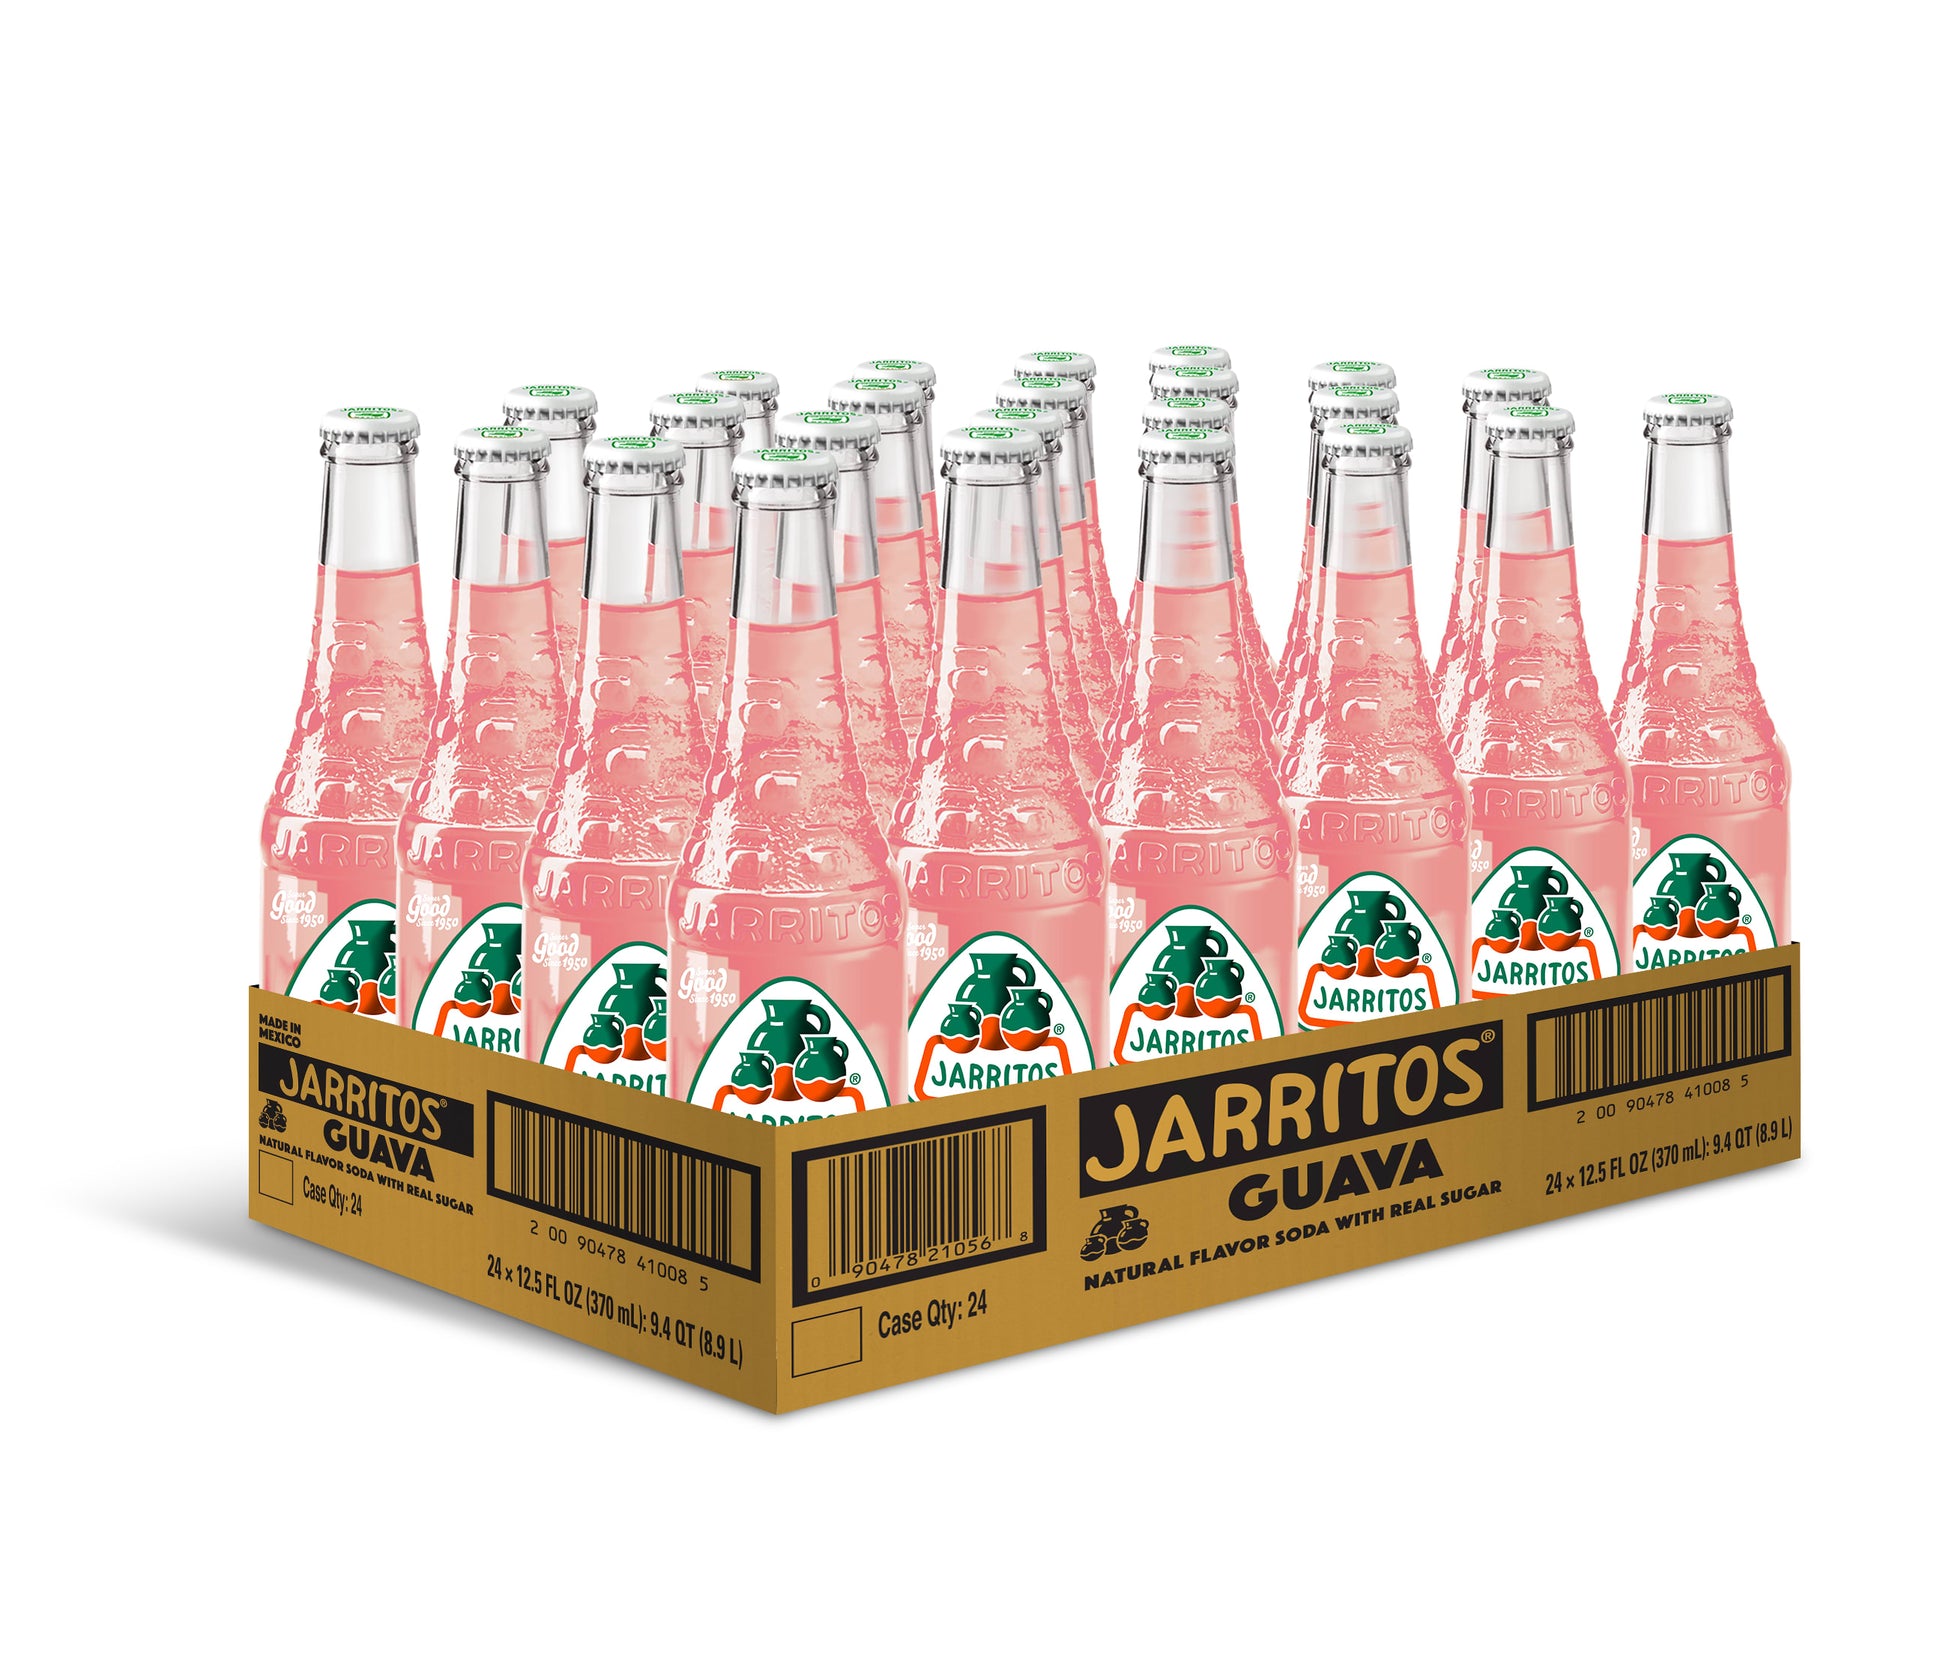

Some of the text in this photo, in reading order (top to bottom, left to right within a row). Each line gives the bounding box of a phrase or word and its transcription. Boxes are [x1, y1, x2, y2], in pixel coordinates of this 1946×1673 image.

[1471, 860, 1489, 873] 950
[270, 890, 316, 920] Good
[1303, 884, 1326, 898] 1950
[300, 913, 325, 928] 1950
[405, 894, 450, 923] Good
[434, 917, 459, 931] 1950
[907, 922, 937, 947] ood
[1119, 919, 1143, 933] 1950
[531, 932, 579, 963] Good
[920, 946, 945, 961] 1950
[562, 956, 588, 971] 1950
[1477, 959, 1589, 986] JARRITOS
[677, 967, 727, 1000] Good
[709, 992, 737, 1007] 1950
[1313, 986, 1427, 1013] JARRITOS
[259, 1013, 301, 1035] MADE IN
[259, 1026, 300, 1048] MEXICO
[453, 1024, 521, 1053] JARRI
[1577, 1074, 1748, 1123] 2 00 90478 41008 5
[323, 1119, 434, 1182] GUAVA
[1546, 1171, 1562, 1195] 24
[1579, 1161, 1606, 1186] 12.5
[1610, 1156, 1625, 1179] FL
[1629, 1150, 1647, 1174] OZ
[1651, 1143, 1678, 1172] (370
[1682, 1136, 1709, 1162] mL):
[1713, 1131, 1731, 1154] 9.4
[1735, 1125, 1752, 1148] QT
[1756, 1120, 1777, 1147] (8.9
[1781, 1115, 1792, 1139] L)
[259, 1134, 473, 1215] NATURAL FLAVOR SODA WITH REAL SUGAR
[1229, 1138, 1443, 1221] GUAVA
[303, 1175, 362, 1216] Case Qty: 24
[1085, 1180, 1501, 1290] NATURAL FLAVOR SODA WITH REAL SUGAR
[530, 1220, 708, 1291] 2 00 90478 41008 5
[811, 1231, 1028, 1289] 0 90478 21056 8
[487, 1254, 501, 1279] 24
[516, 1264, 541, 1294] 12.5
[545, 1273, 560, 1301] FL
[564, 1280, 582, 1309] OZ
[586, 1287, 613, 1320] (370
[617, 1303, 646, 1334] mL):
[651, 1311, 670, 1340] 9.4
[675, 1319, 695, 1348] QT
[699, 1327, 725, 1360] (8.9
[729, 1338, 742, 1370] L)
[879, 1289, 986, 1338] Case Qty: 24
